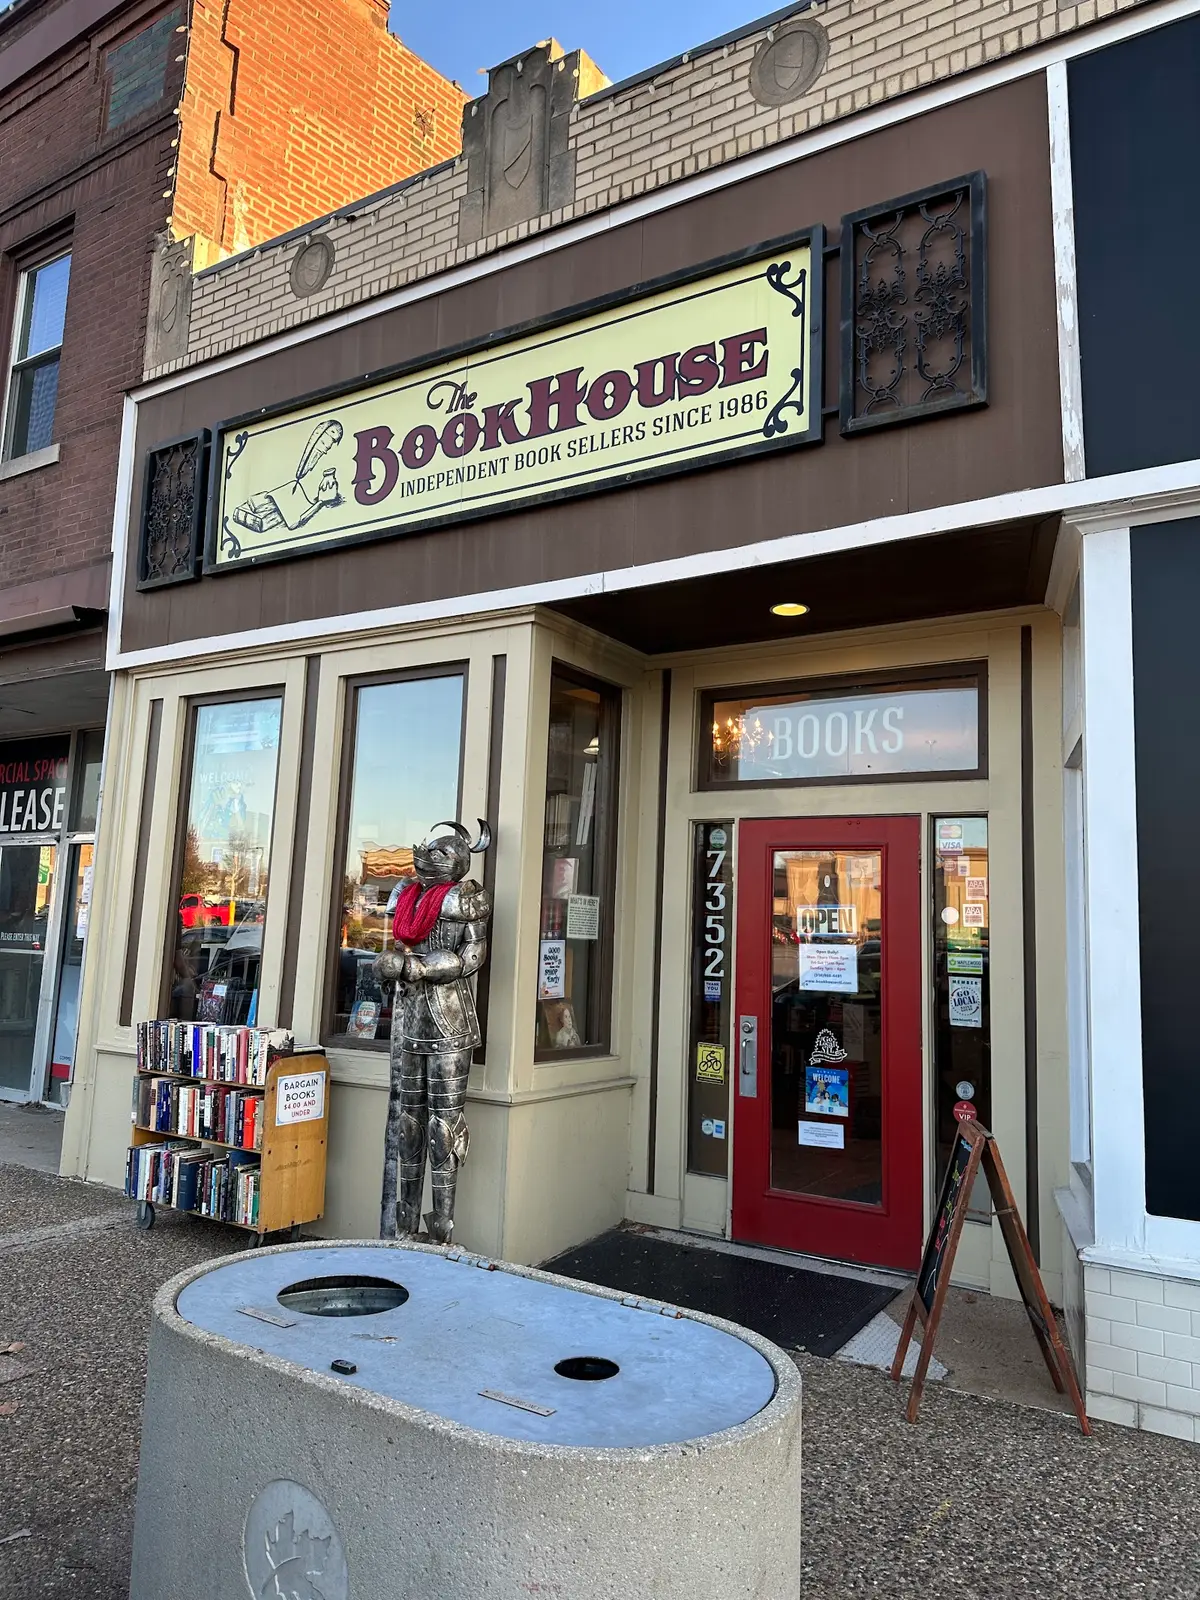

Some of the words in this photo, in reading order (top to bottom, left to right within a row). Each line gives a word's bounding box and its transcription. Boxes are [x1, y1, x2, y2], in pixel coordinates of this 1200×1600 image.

[427, 381, 477, 414] The
[400, 456, 510, 498] INDEPENDENT
[514, 443, 562, 471] BOOK
[567, 421, 646, 458] SELLERS
[652, 404, 712, 436] SINCE
[719, 390, 768, 419] 1986
[773, 706, 904, 760] BOOKS
[0, 787, 66, 831] LEASE
[942, 841, 961, 849] VISA
[704, 850, 727, 978] 7352
[801, 908, 854, 933] OPEN
[953, 996, 978, 1007] LOCAL
[284, 1078, 319, 1090] BARGAIN
[812, 1073, 840, 1084] WELCOME
[285, 1090, 316, 1102] BOOKS
[284, 1102, 301, 1110] $4.00
[303, 1099, 316, 1107] AND
[291, 1109, 311, 1117] UNDER
